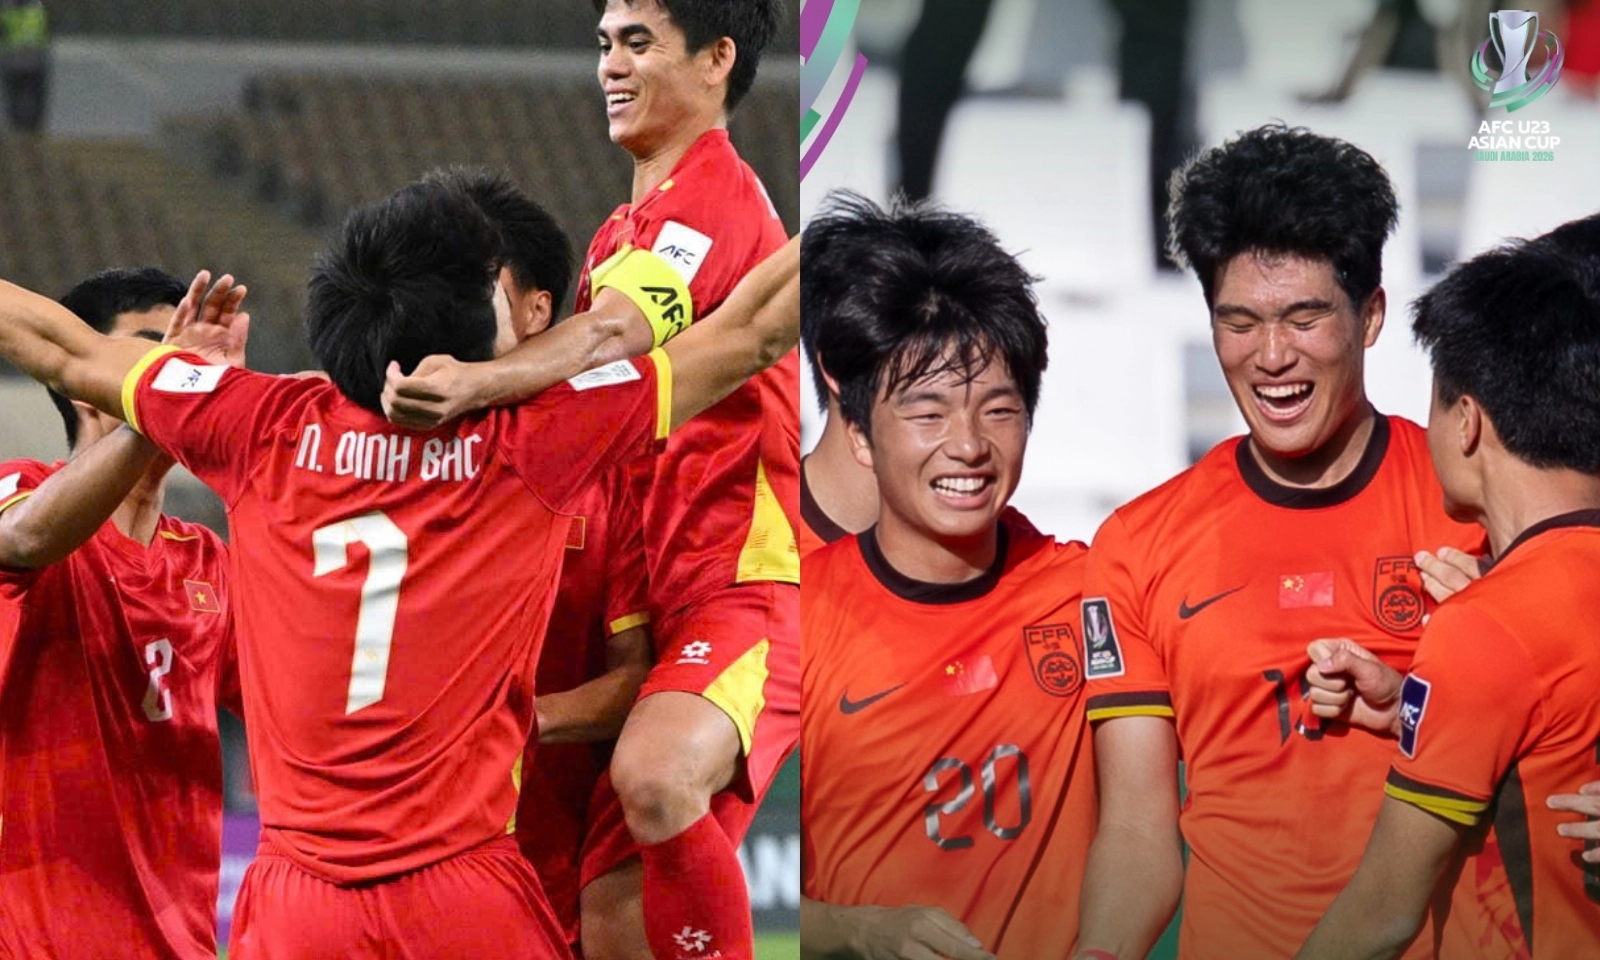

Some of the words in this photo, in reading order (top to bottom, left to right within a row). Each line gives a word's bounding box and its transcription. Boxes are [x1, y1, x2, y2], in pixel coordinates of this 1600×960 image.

[658, 244, 696, 266] AFC
[335, 430, 411, 482] DINH
[420, 433, 482, 482] BAC
[312, 510, 408, 715] 7
[141, 637, 174, 722] 2
[1263, 668, 1325, 747] 1
[924, 744, 1032, 852] 20
